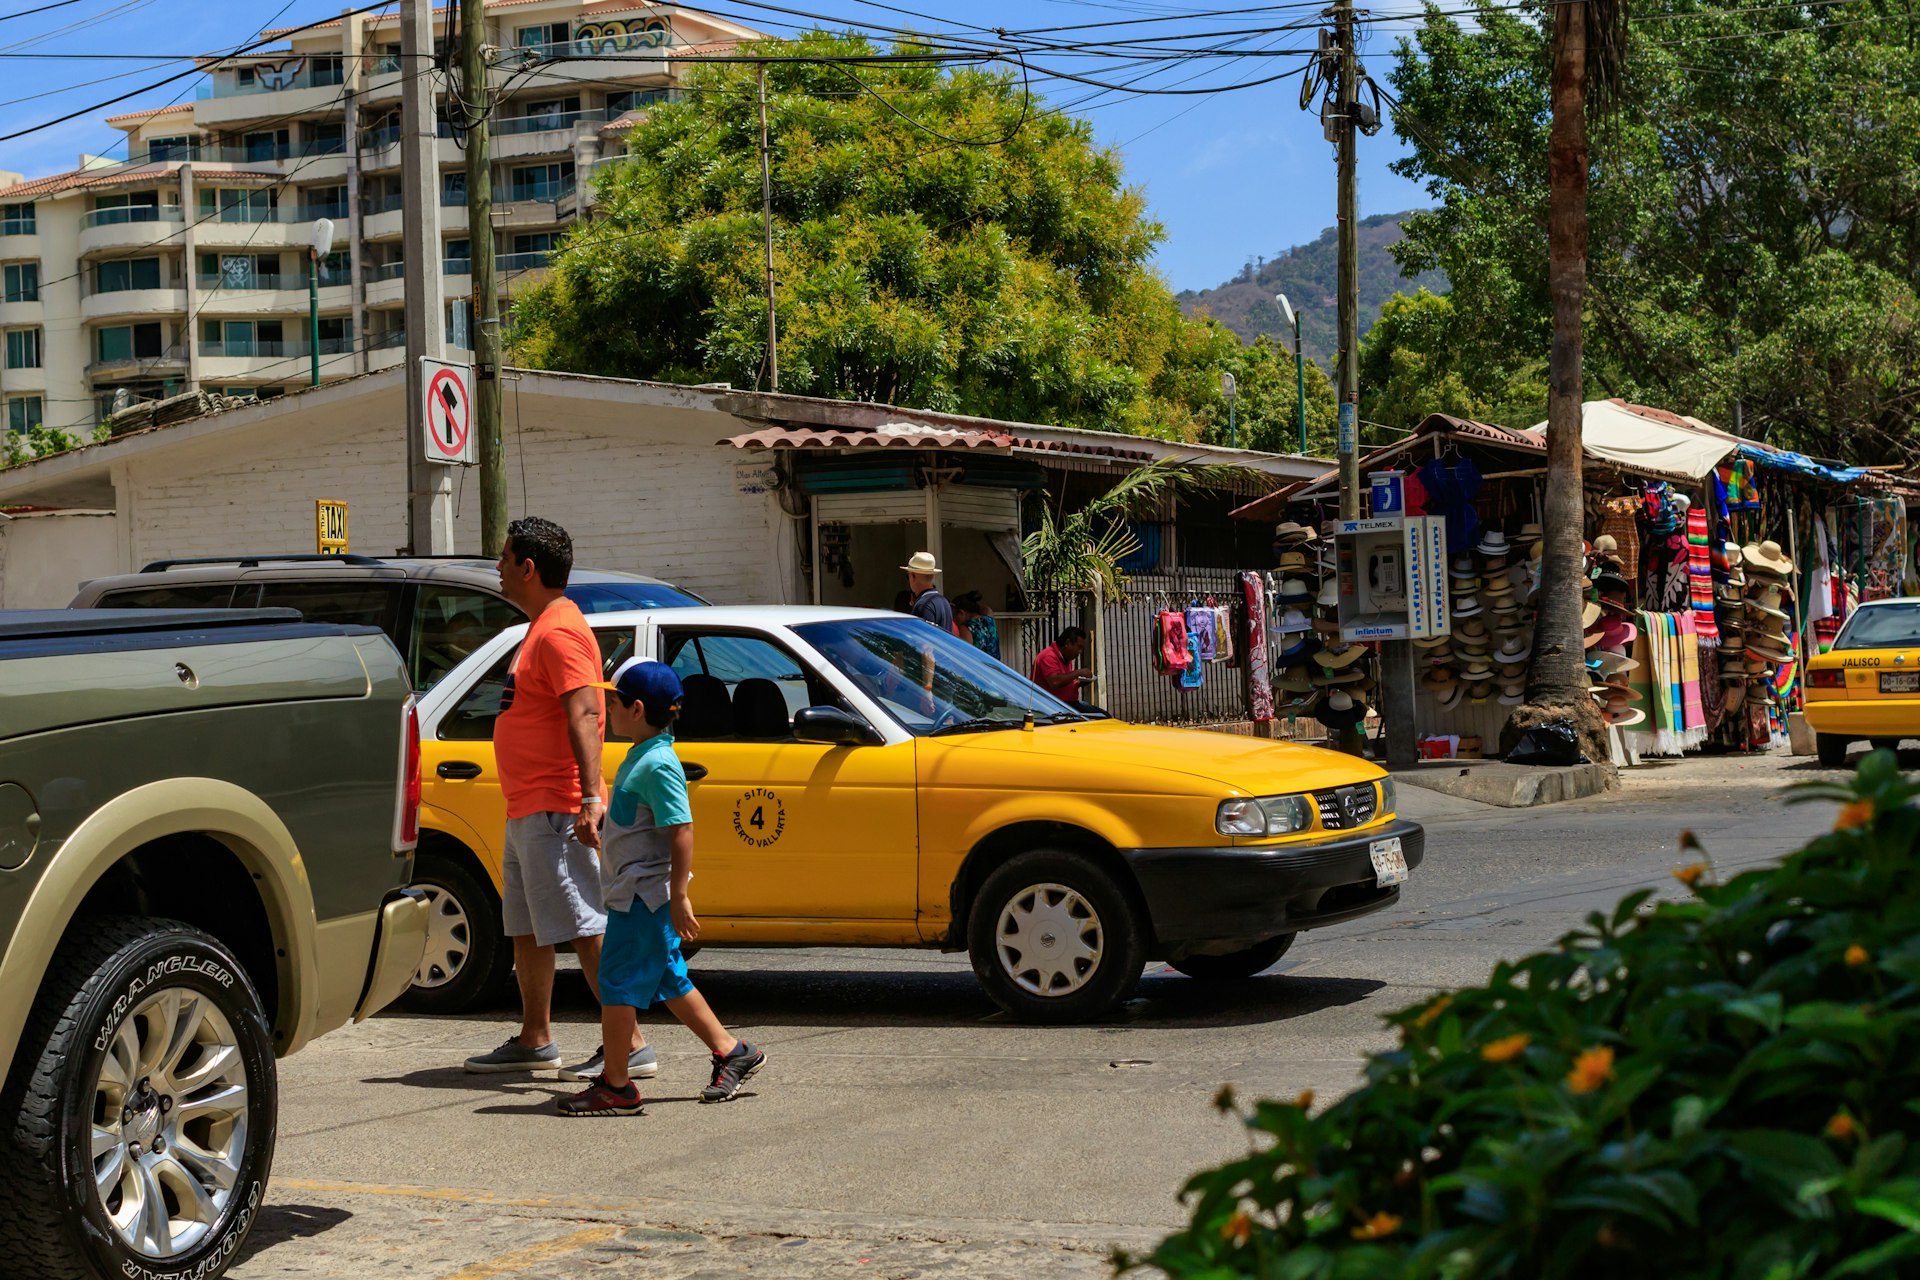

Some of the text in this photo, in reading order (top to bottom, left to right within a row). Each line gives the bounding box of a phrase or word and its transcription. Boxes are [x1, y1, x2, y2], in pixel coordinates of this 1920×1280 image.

[325, 506, 345, 539] TAXI
[1360, 521, 1393, 529] TELMEX
[1411, 527, 1421, 631] infinitum
[1433, 526, 1443, 629] infinitum
[1355, 627, 1393, 636] infinitum
[1842, 657, 1880, 667] JALISCO
[744, 788, 775, 801] SITIO
[733, 809, 785, 848] PUERTO VALLARTA
[750, 805, 765, 830] 4
[94, 955, 234, 1051] WRANGLER
